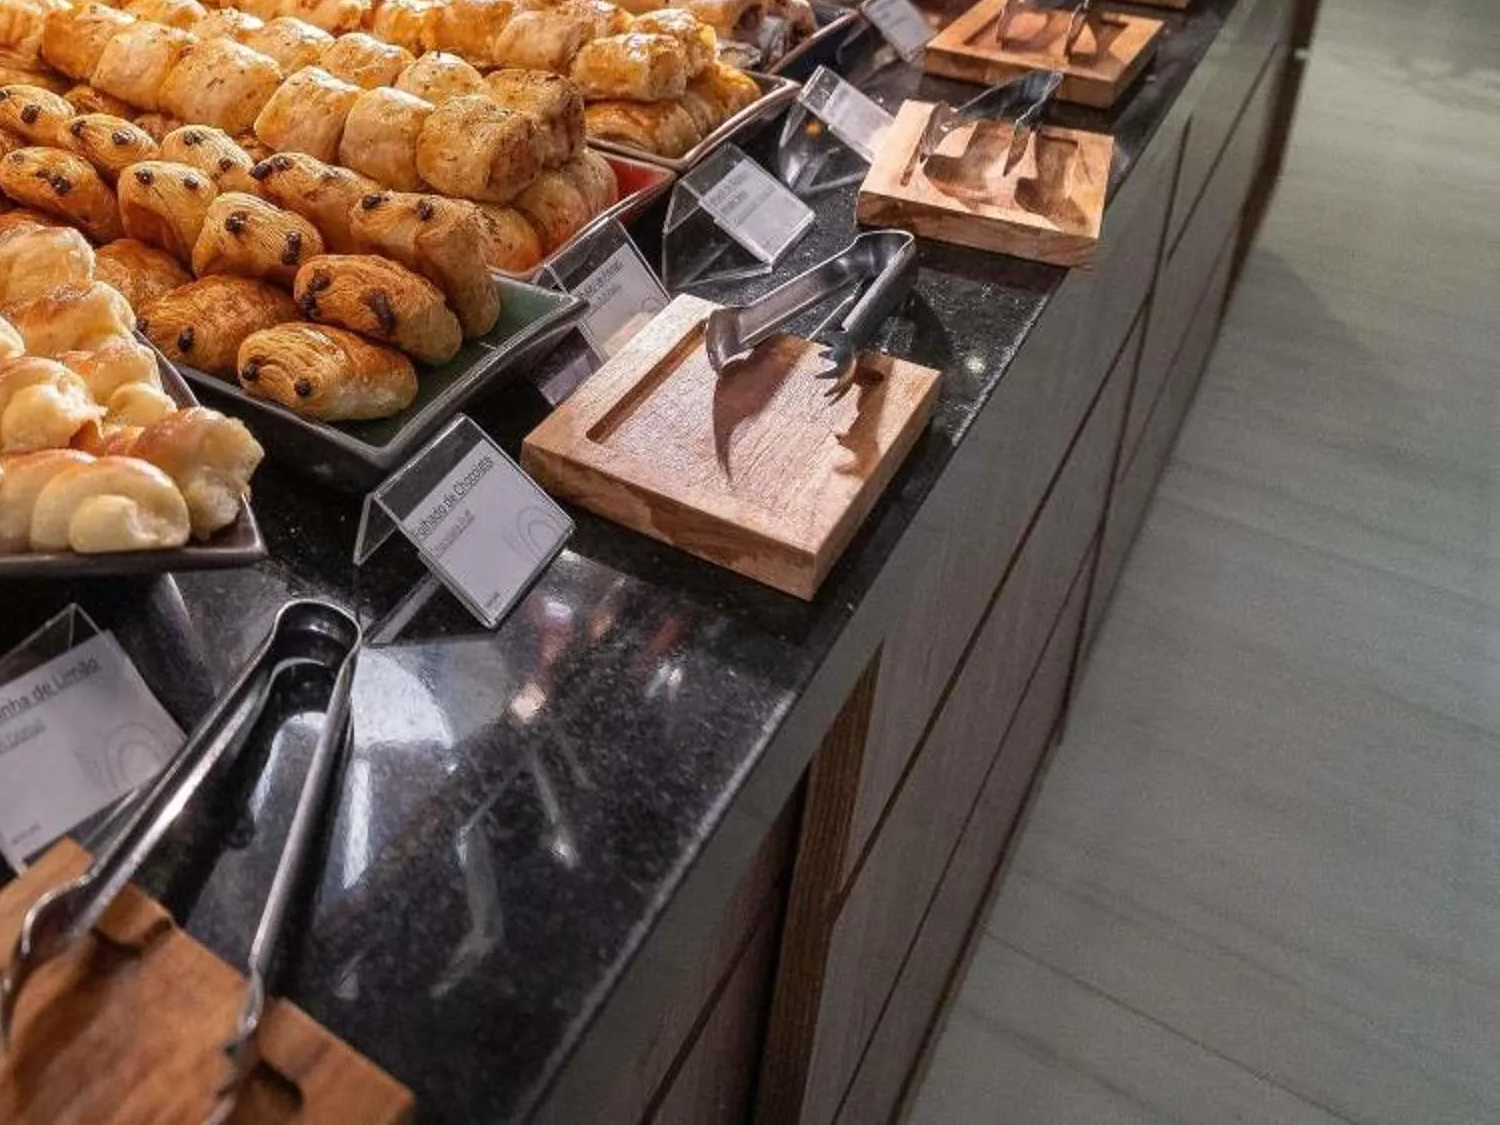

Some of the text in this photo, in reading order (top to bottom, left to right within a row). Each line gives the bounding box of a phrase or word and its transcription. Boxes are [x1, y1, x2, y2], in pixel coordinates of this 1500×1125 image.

[440, 489, 458, 508] de
[450, 453, 495, 498] Chocolate
[30, 679, 55, 704] de
